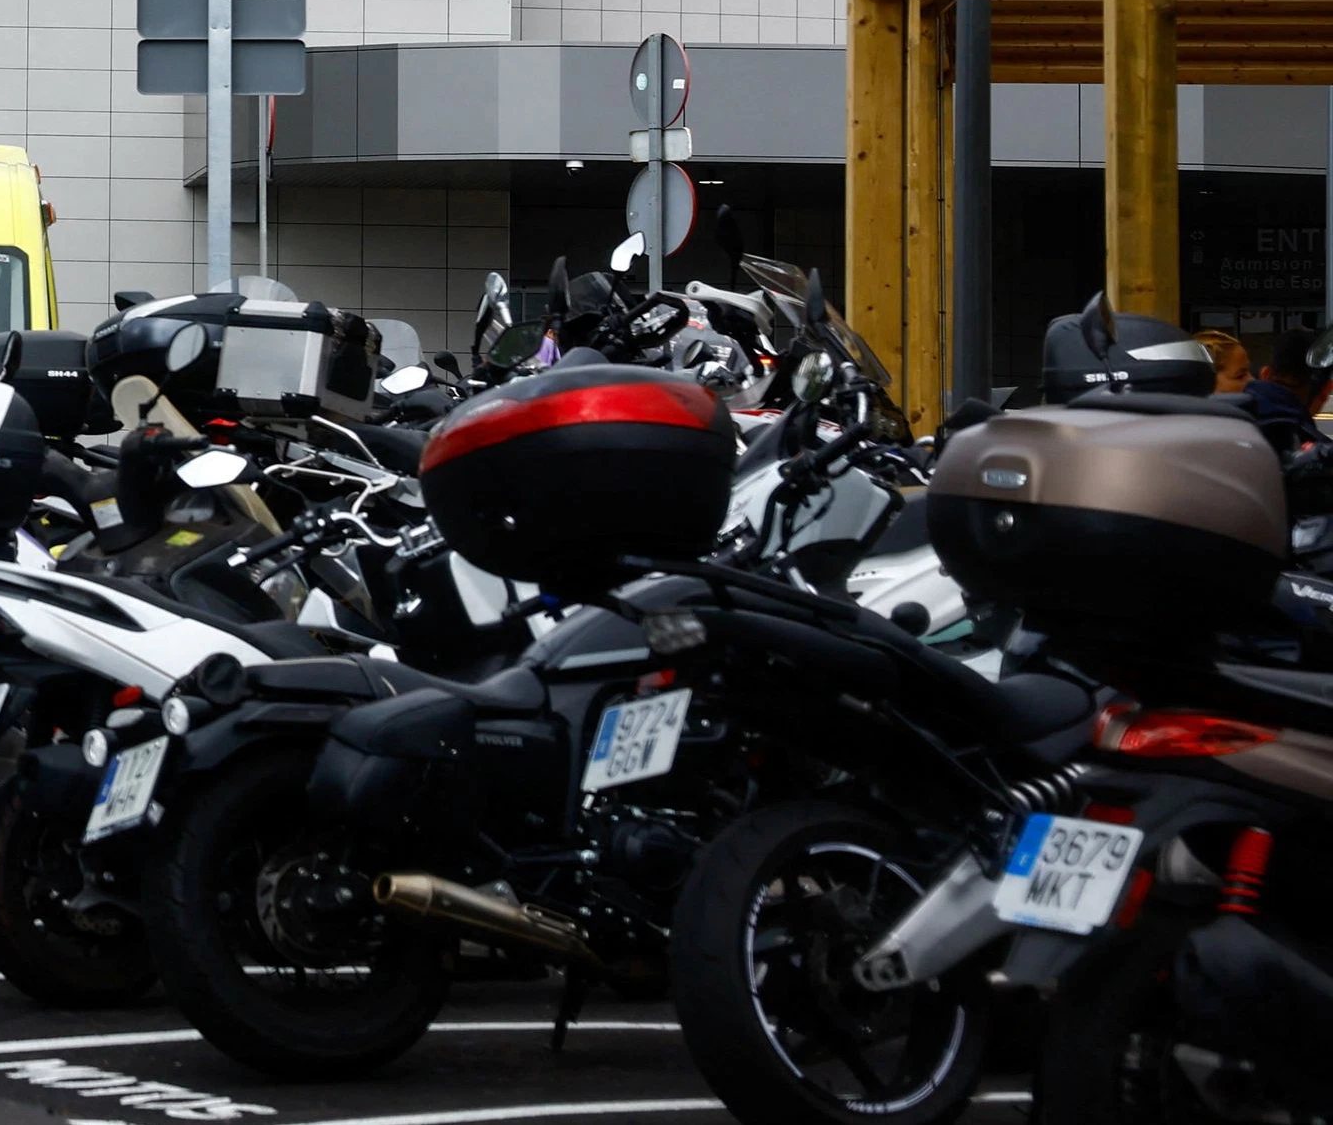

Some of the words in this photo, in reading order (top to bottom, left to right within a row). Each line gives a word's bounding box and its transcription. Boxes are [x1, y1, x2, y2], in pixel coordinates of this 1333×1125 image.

[1256, 228, 1327, 252] ENT
[1290, 275, 1327, 291] Esp
[47, 370, 79, 378] SH44
[1040, 828, 1131, 871] 3679
[1023, 870, 1095, 911] MKT
